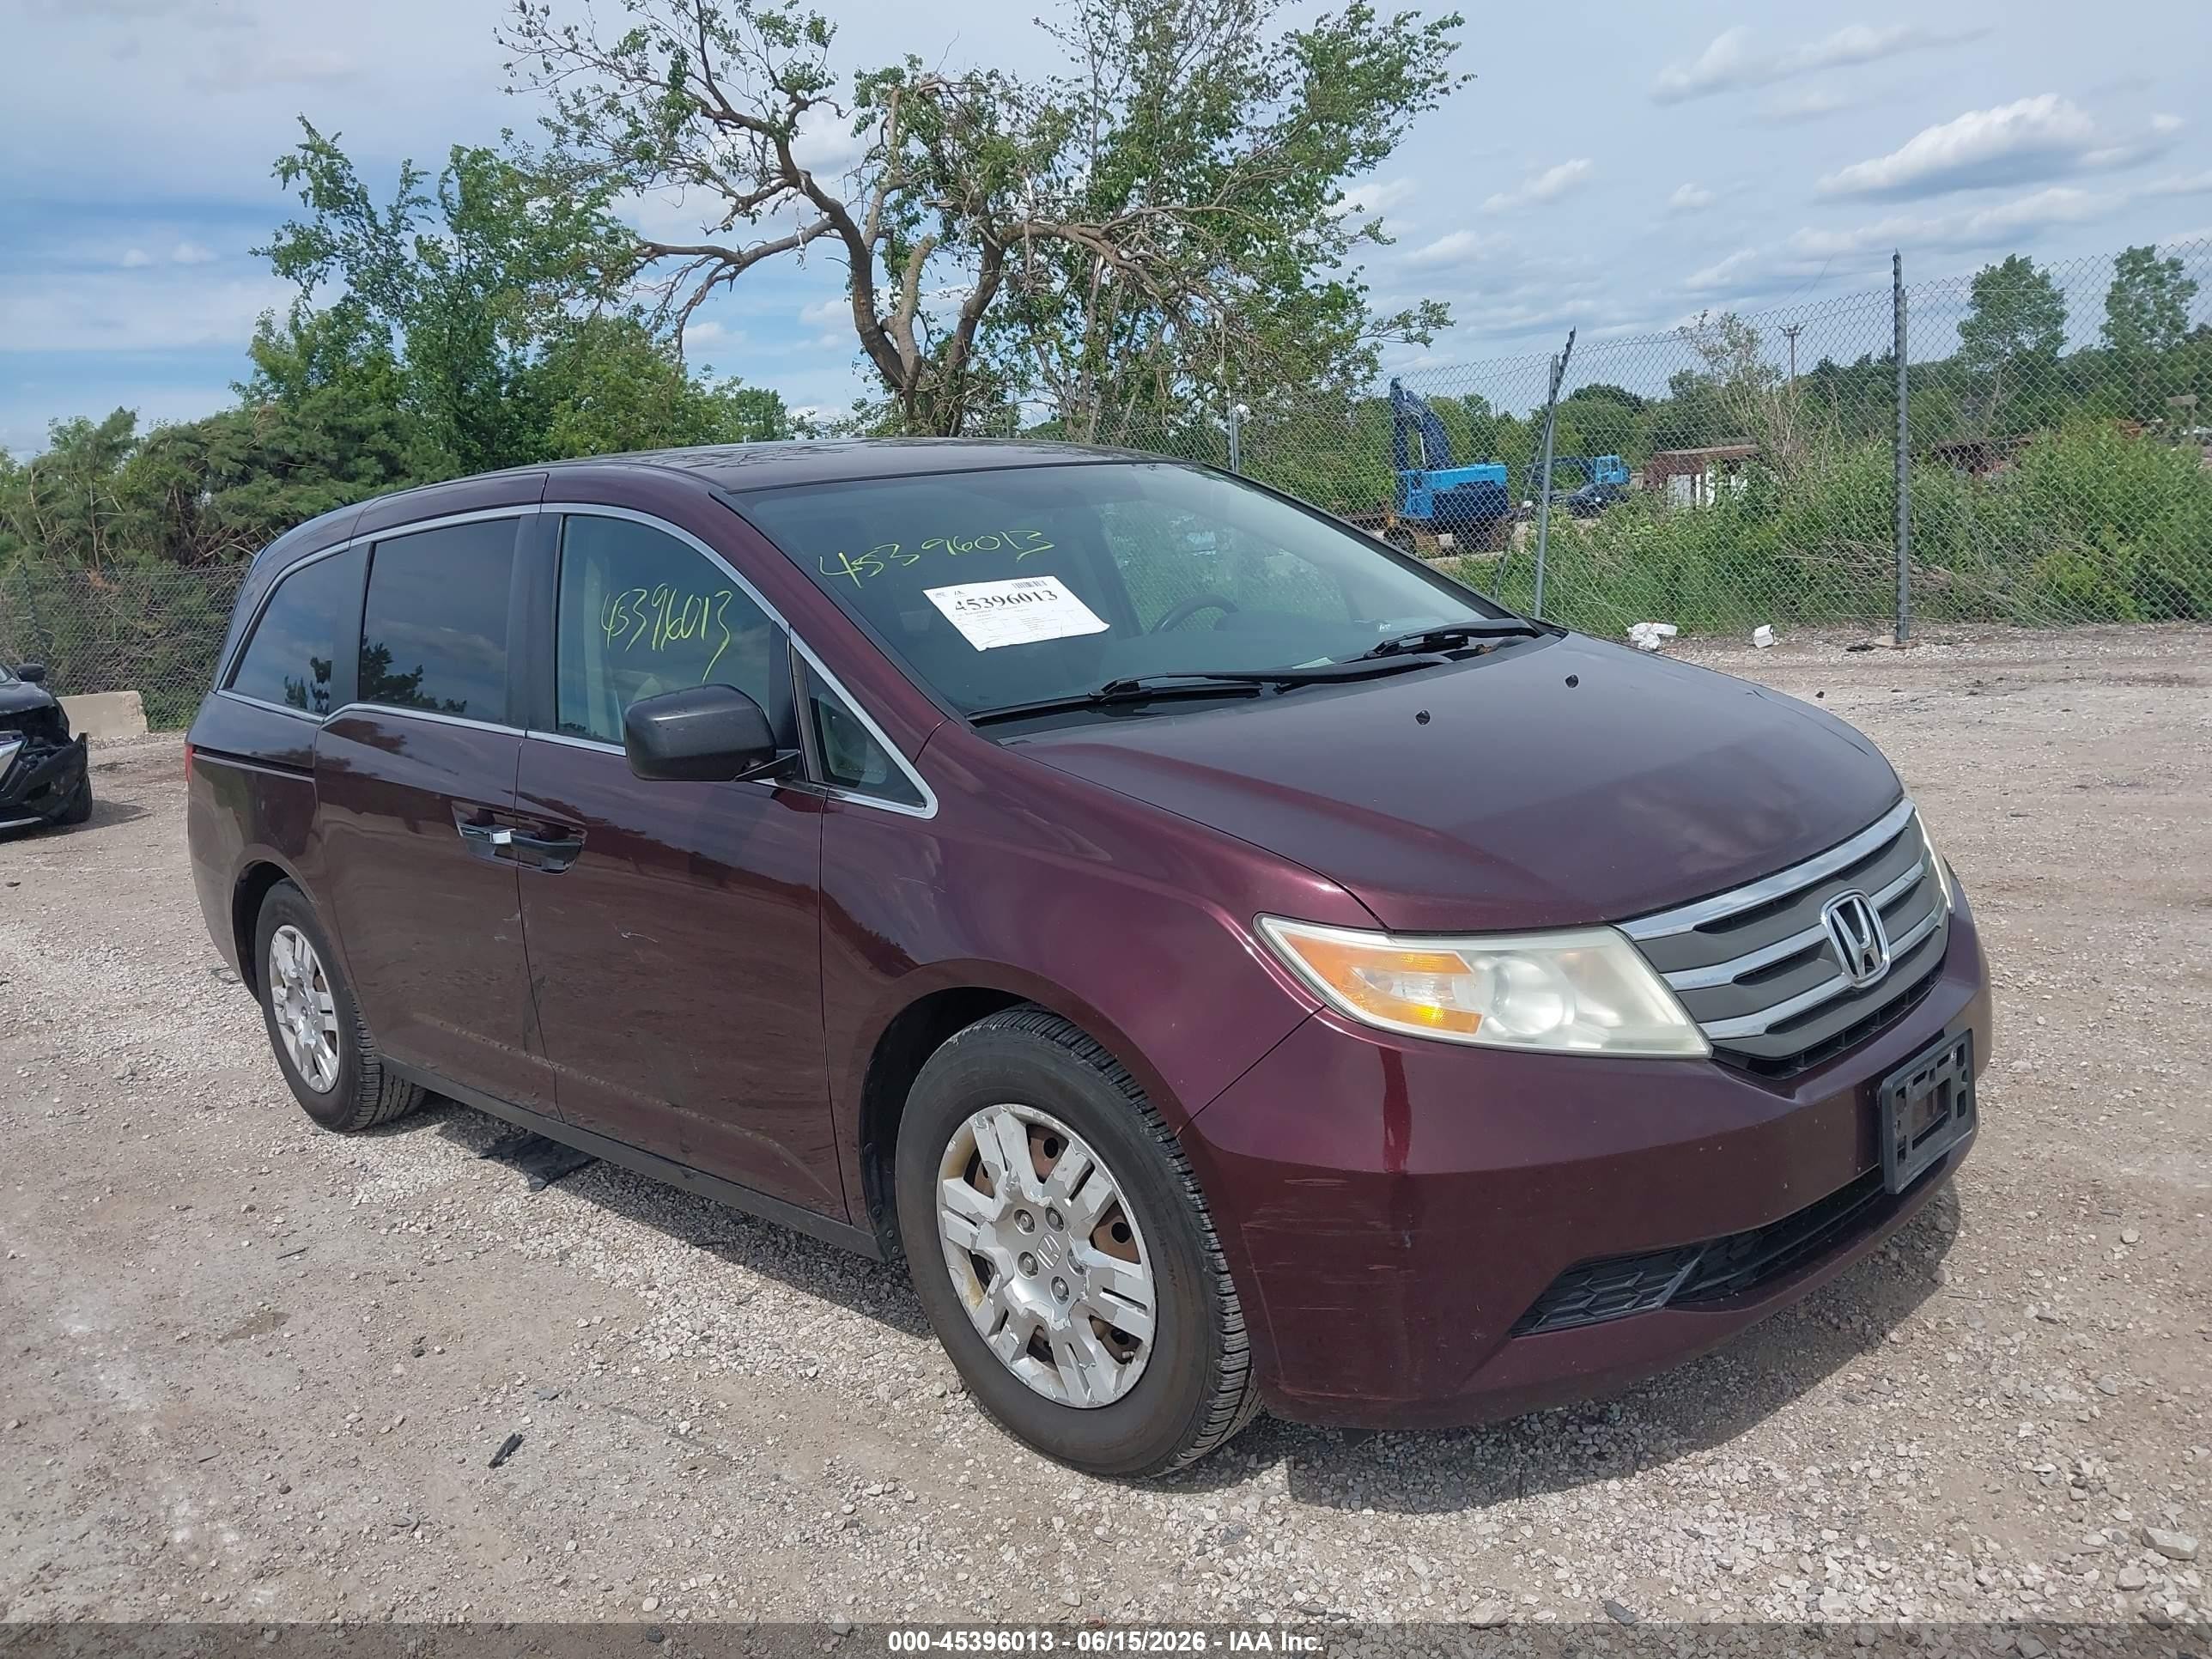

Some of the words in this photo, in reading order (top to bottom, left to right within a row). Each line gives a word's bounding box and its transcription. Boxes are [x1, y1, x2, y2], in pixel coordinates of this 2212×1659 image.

[818, 529, 1055, 589] 45396013
[955, 590, 1058, 611] 45396013
[600, 582, 733, 684] 45396013
